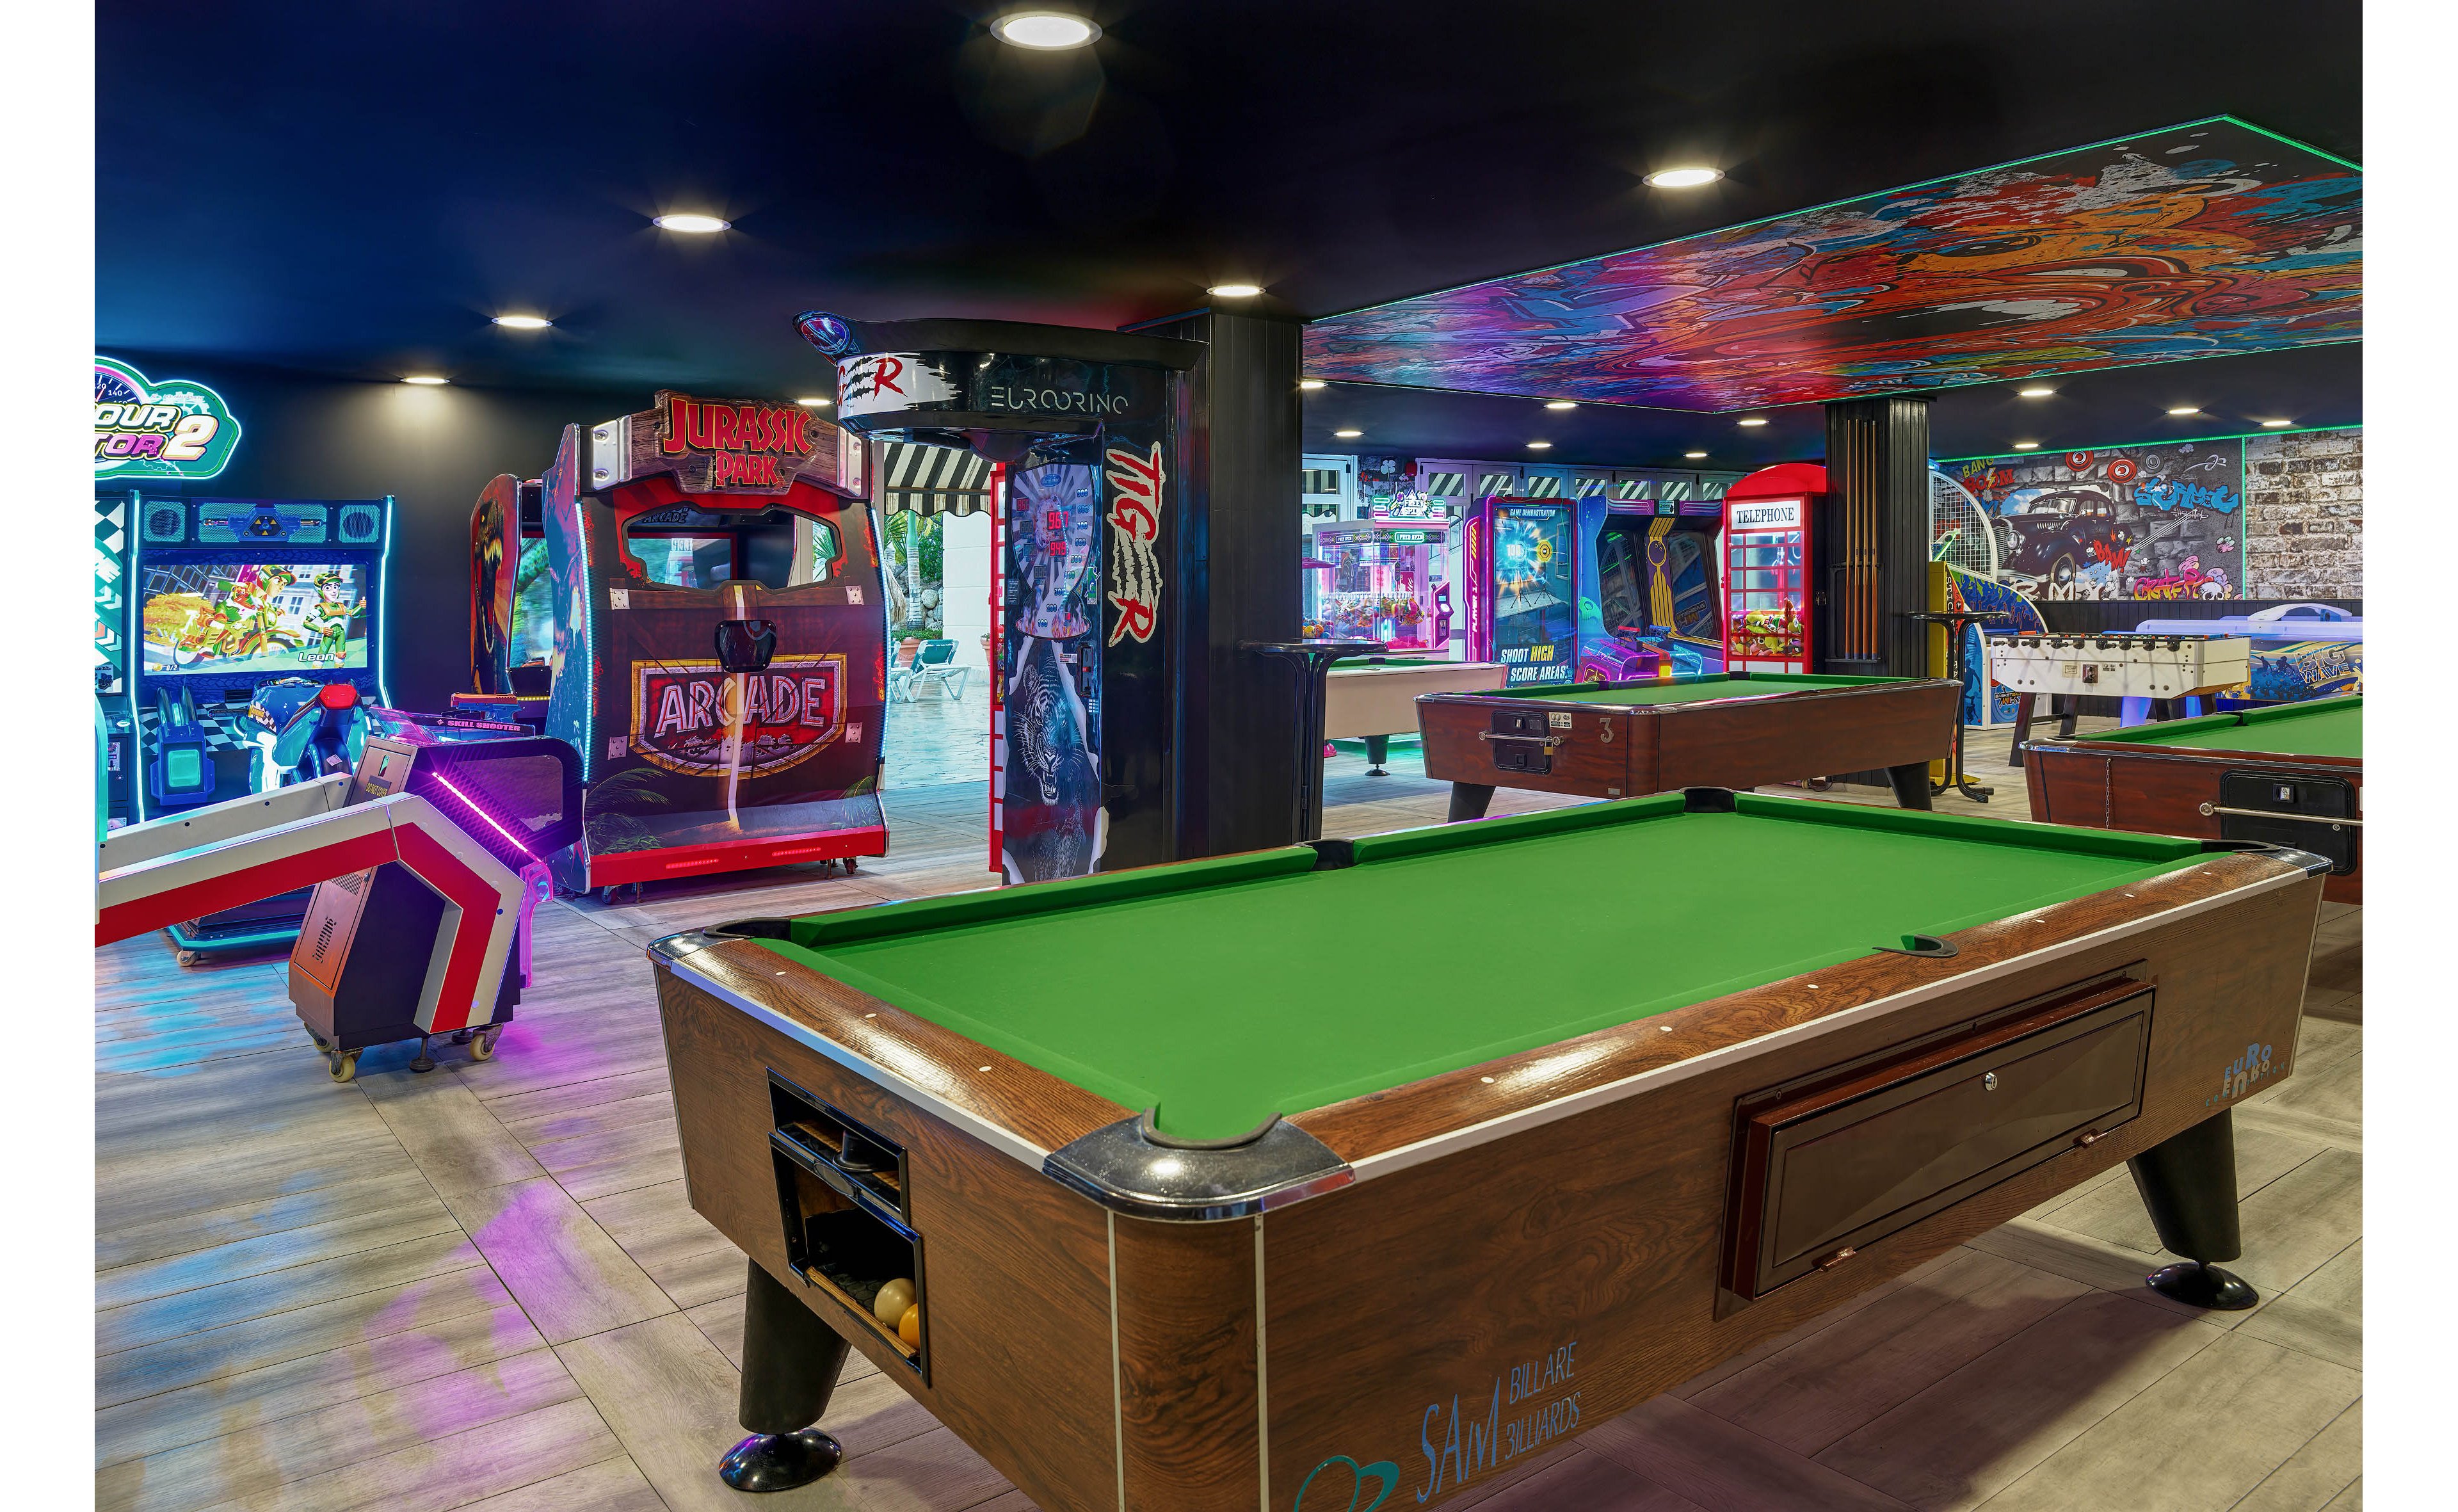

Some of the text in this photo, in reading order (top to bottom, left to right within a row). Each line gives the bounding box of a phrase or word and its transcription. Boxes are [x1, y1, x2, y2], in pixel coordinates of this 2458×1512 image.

[162, 414, 219, 461] 2
[664, 398, 812, 454] JURASSIC
[716, 450, 780, 487] PARK
[1962, 458, 1994, 478] BANG
[1963, 469, 2015, 494] BOOM
[1048, 511, 1068, 529] 967
[1522, 508, 1555, 517] DEMONSTRATION
[1737, 507, 1794, 524] TELEPHONE
[298, 651, 335, 662] Leon
[1500, 645, 1554, 663] SHOOT HIGH
[2294, 645, 2346, 673] BIG
[1510, 667, 1538, 682] SCORE
[2300, 663, 2351, 684] WAVE
[654, 675, 826, 738] ARCADE
[447, 720, 520, 732] SKILL SHOOTER
[1599, 717, 1614, 743] 3
[2224, 1043, 2272, 1079] EURO
[1416, 1376, 1500, 1504] SAM
